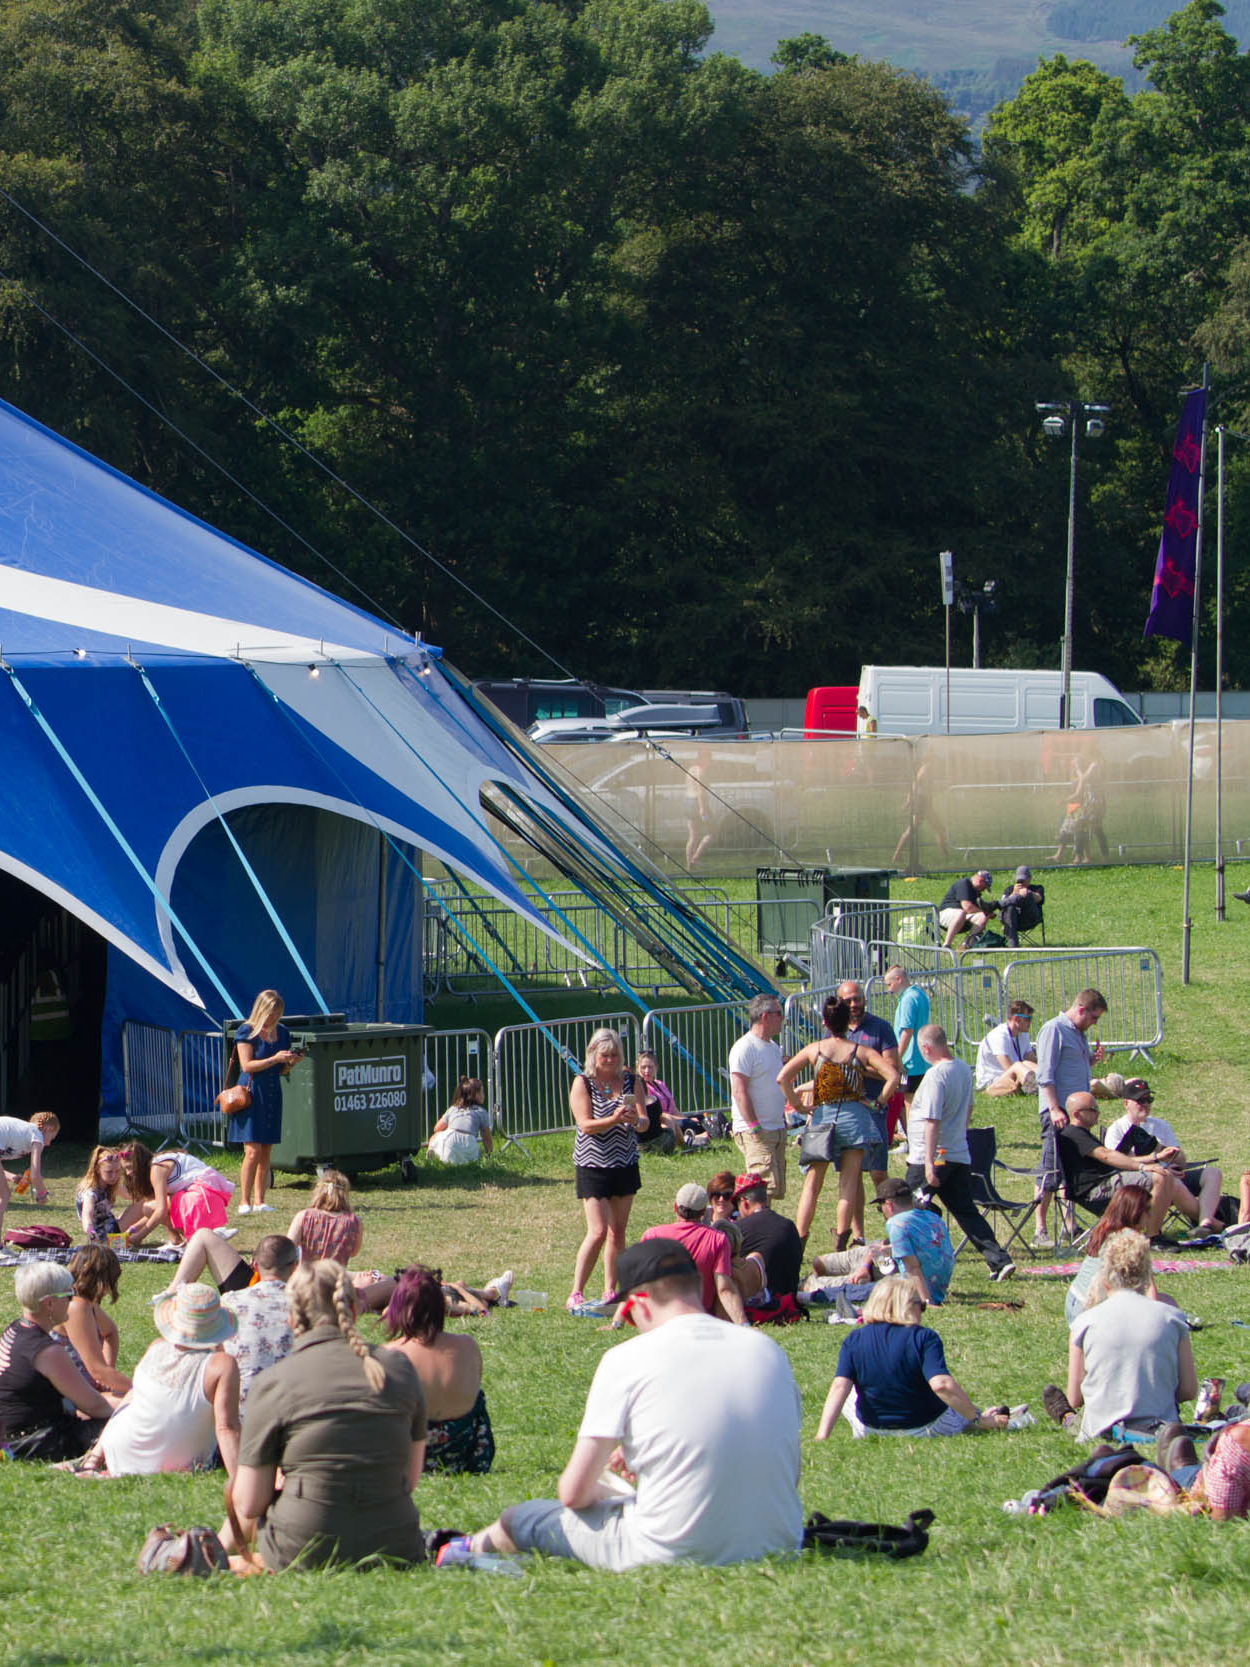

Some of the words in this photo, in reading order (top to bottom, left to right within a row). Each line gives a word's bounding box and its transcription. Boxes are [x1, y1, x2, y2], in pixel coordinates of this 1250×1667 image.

[338, 1064, 402, 1087] PatMunro
[334, 1094, 367, 1112] 01463
[369, 1090, 407, 1109] 226080
